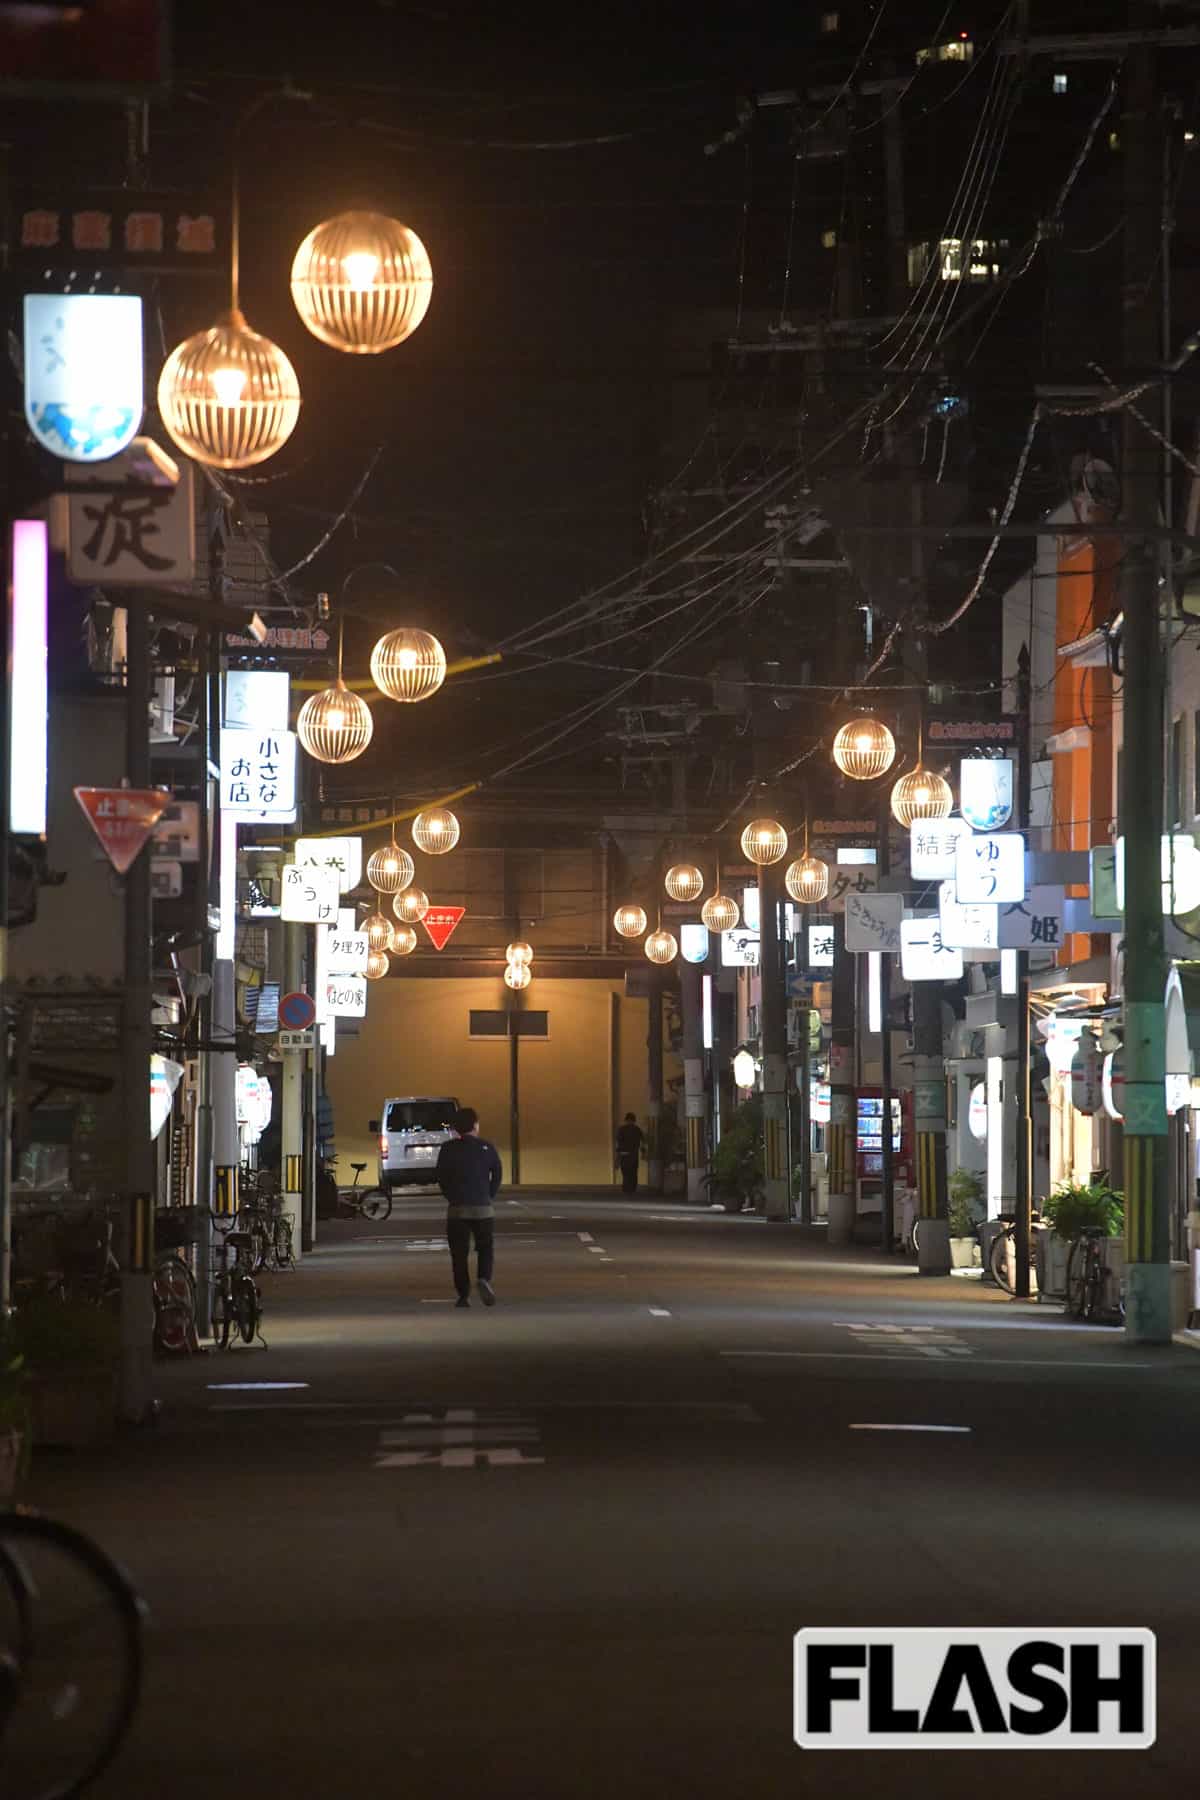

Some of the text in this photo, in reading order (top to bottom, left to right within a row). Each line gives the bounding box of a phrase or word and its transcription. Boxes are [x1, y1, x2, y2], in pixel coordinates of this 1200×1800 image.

[229, 758, 251, 802] お店
[259, 737, 279, 803] 小さな
[975, 840, 1000, 897] ゆう
